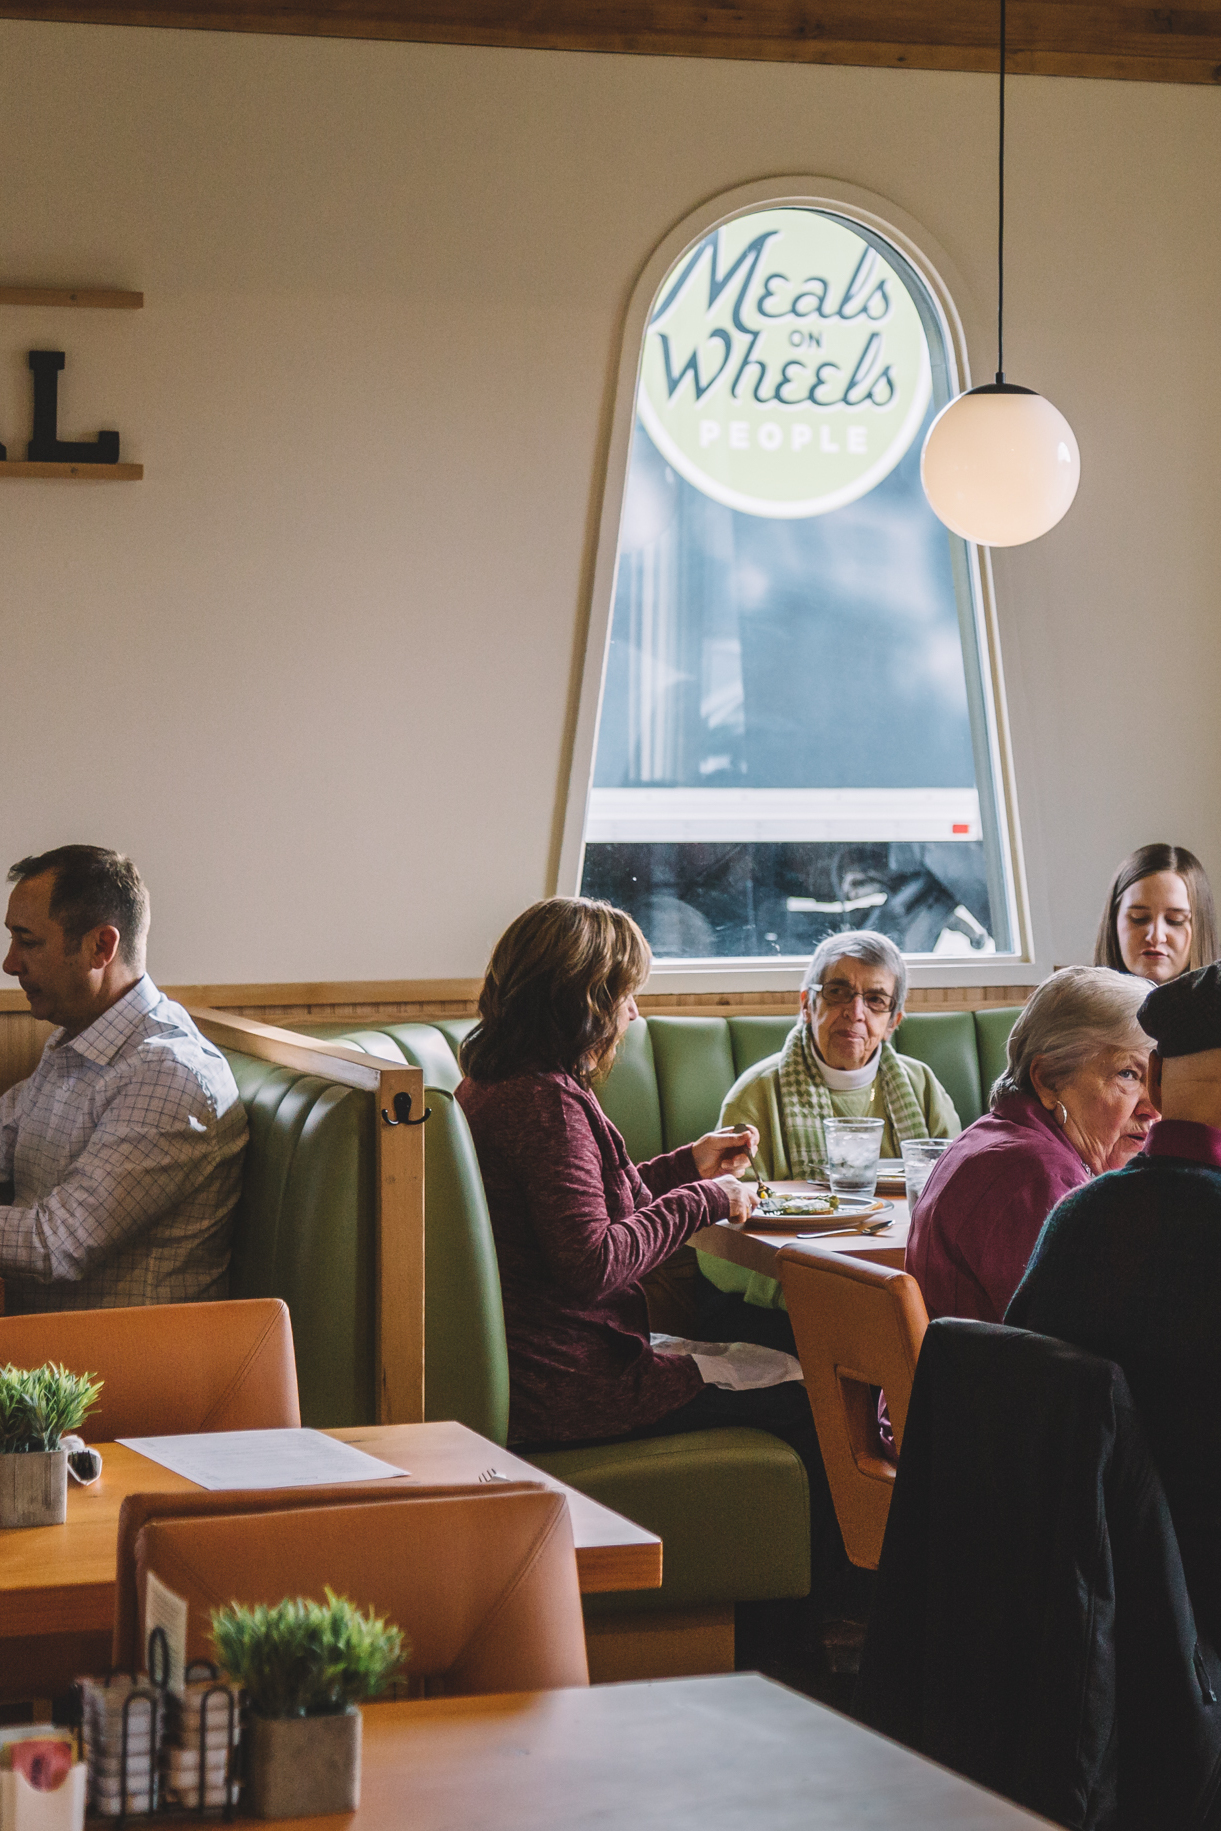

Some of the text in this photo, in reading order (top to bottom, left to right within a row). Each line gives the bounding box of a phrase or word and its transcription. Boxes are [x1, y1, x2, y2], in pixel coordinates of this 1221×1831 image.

[651, 229, 891, 333] Meals
[658, 328, 895, 406] Wheels
[790, 331, 822, 348] ON
[0, 350, 120, 463] L
[701, 420, 868, 454] PEOPLE
